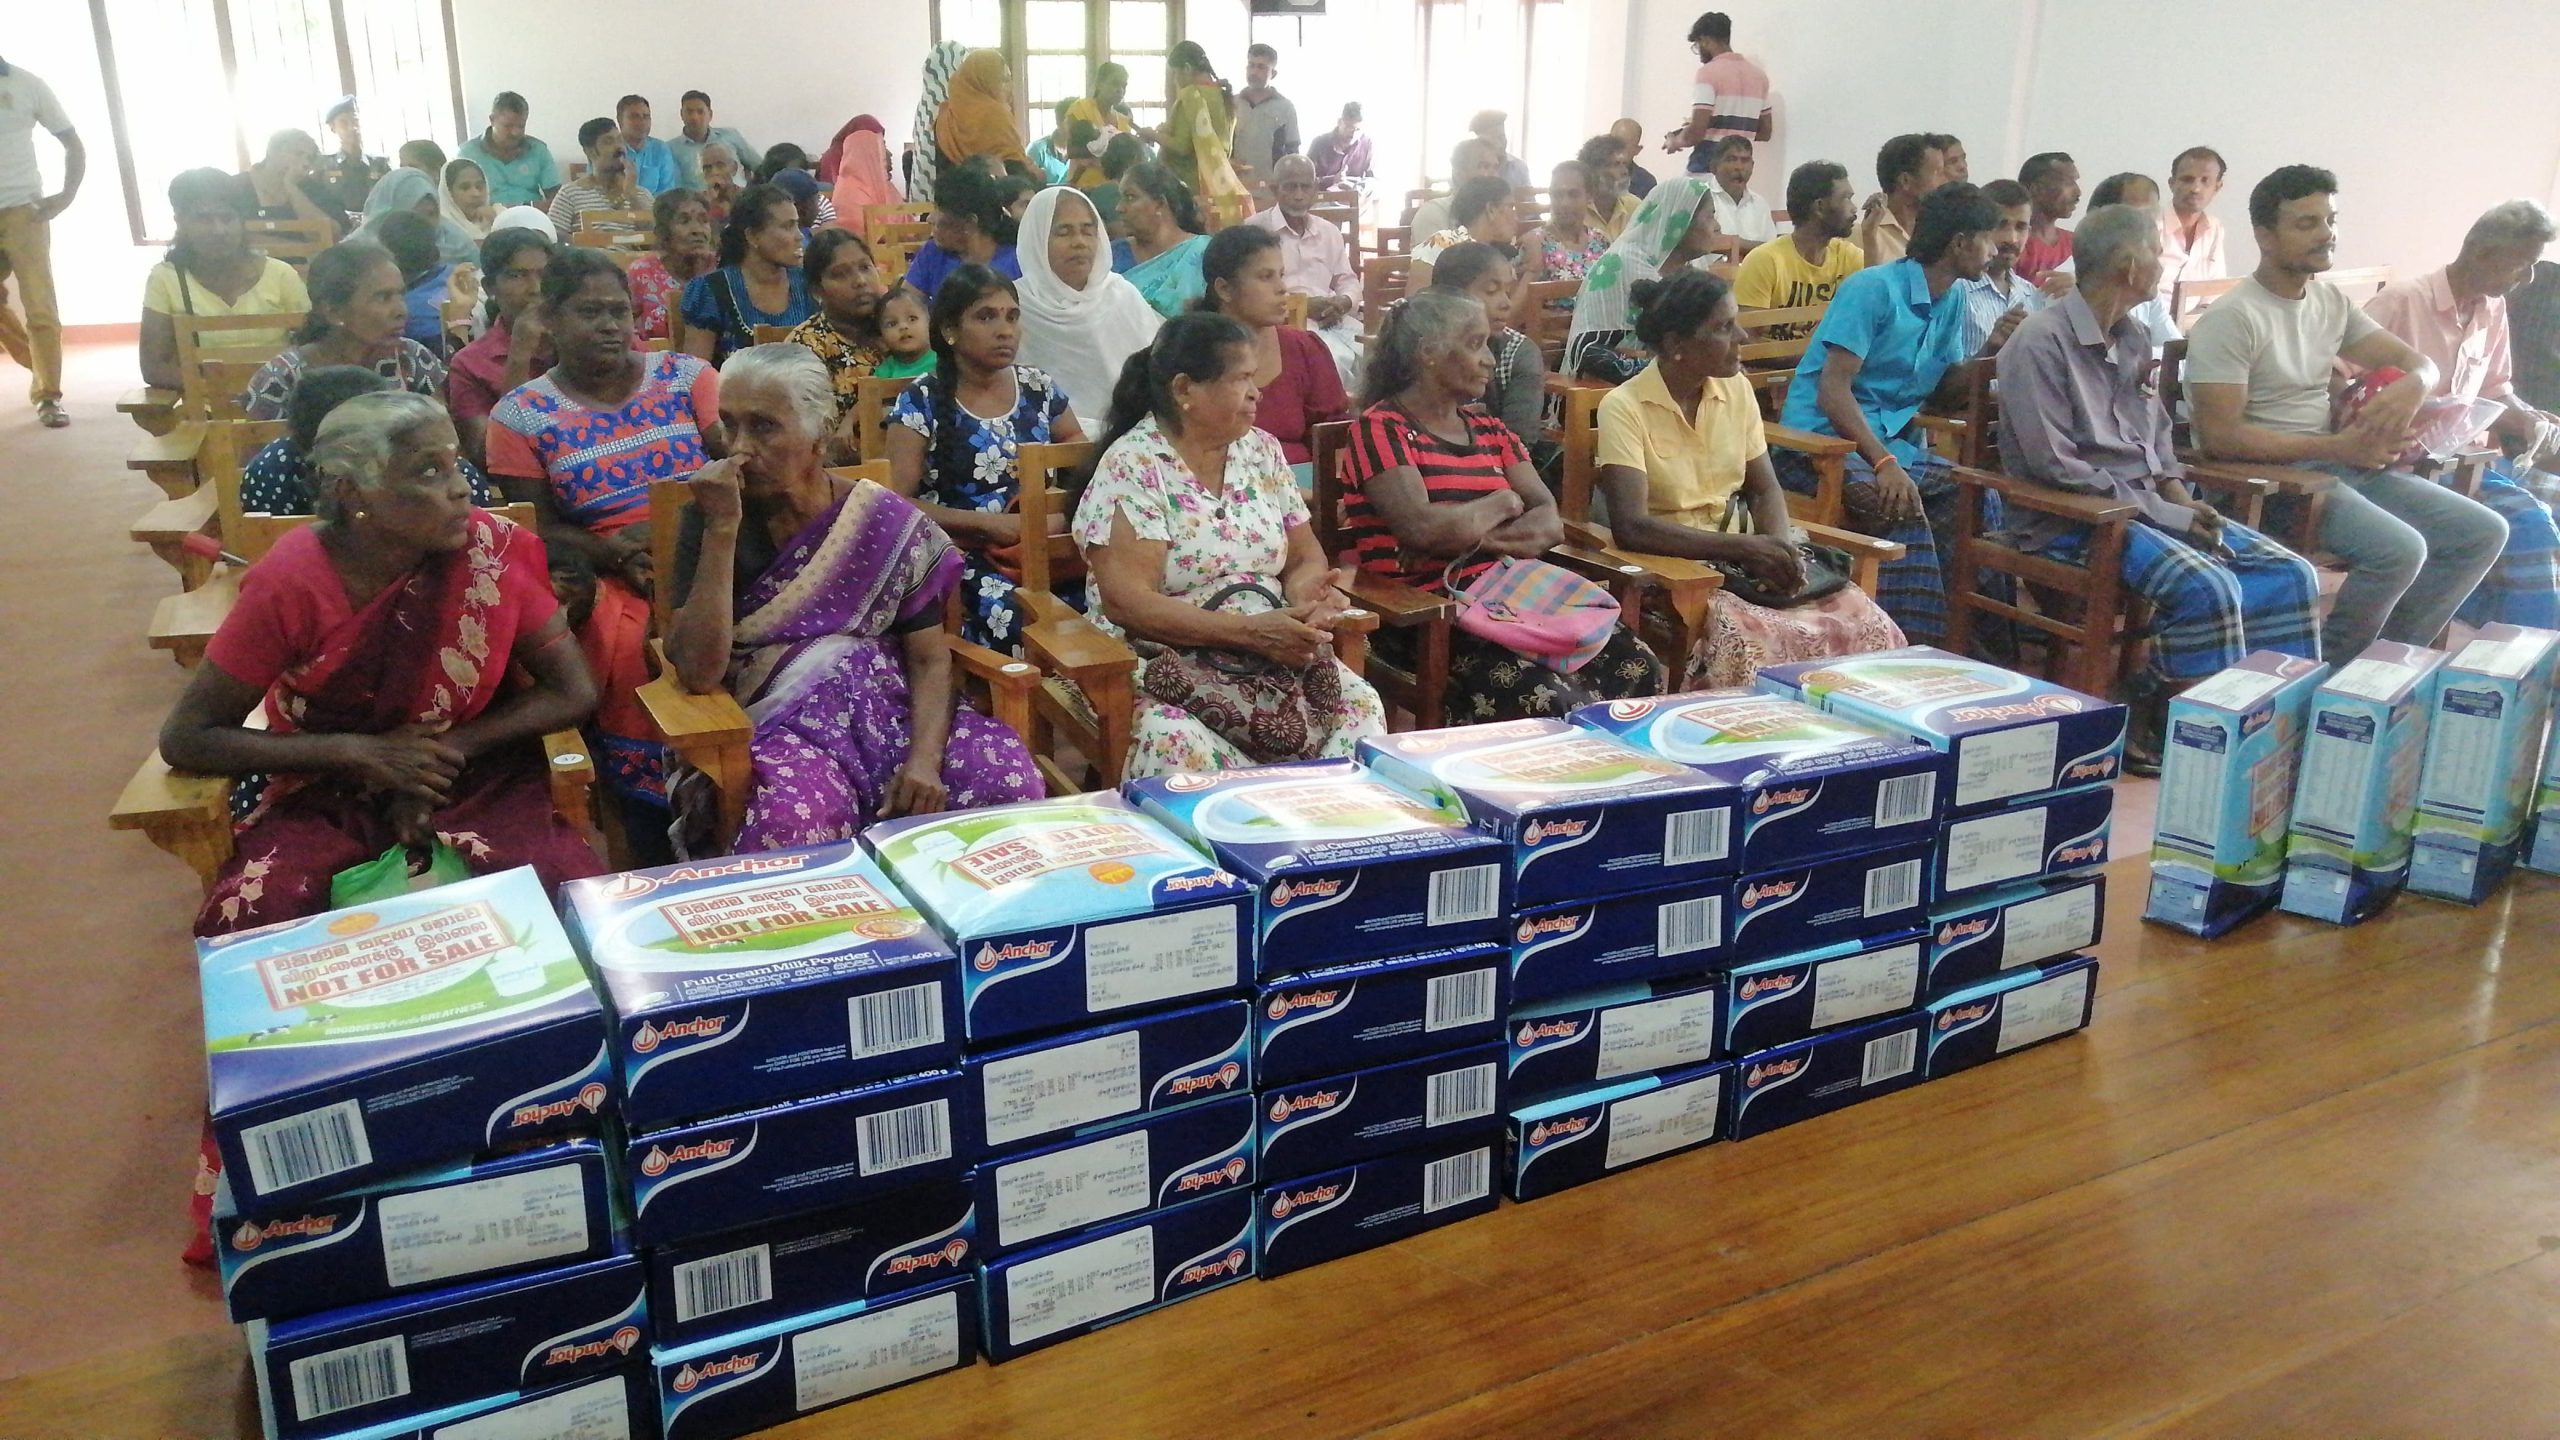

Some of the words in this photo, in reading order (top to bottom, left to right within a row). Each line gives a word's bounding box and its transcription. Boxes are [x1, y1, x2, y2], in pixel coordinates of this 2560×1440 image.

[1778, 275, 1843, 308] JUS
[1772, 788, 1810, 804] Anchor
[1542, 819, 1588, 837] Anchor
[1328, 838, 1371, 850] Cream
[1371, 834, 1396, 845] Milk
[1396, 831, 1442, 842] Powder
[663, 852, 811, 886] Anchor
[1166, 869, 1220, 893] Anchor
[1292, 878, 1342, 897] Anchor
[1758, 881, 1796, 898] Anchor
[694, 919, 757, 943] NOT
[759, 909, 815, 932] FOR
[820, 898, 886, 919] SALE
[1535, 915, 1579, 932] Anchor
[1953, 919, 1988, 936] Anchor
[999, 939, 1056, 961] Anchor
[284, 974, 350, 1003] NOT
[356, 957, 420, 986] FOR
[424, 932, 499, 965] SALE
[683, 975, 716, 989] Full
[716, 966, 773, 982] Cream
[773, 958, 811, 972] Milk
[808, 950, 870, 967] Powder
[1758, 974, 1796, 990] Anchor
[1289, 989, 1337, 1008] Anchor
[1953, 1004, 1987, 1021] Anchor
[660, 1015, 727, 1039] Anchor
[1535, 1020, 1579, 1037] Anchor
[1763, 1058, 1801, 1076] Anchor
[1170, 1071, 1220, 1095] Anchor
[1291, 1089, 1339, 1110] Anchor
[511, 1097, 580, 1128] Anchor
[1547, 1116, 1590, 1134] Anchor
[669, 1138, 735, 1162] Anchor
[1177, 1168, 1228, 1192] Anchor
[1291, 1183, 1339, 1203] Anchor
[262, 1213, 337, 1238] Anchor
[887, 1247, 947, 1274] Anchor
[1182, 1259, 1229, 1283] Anchor
[545, 1335, 614, 1365] Anchor
[699, 1351, 760, 1379] Anchor
